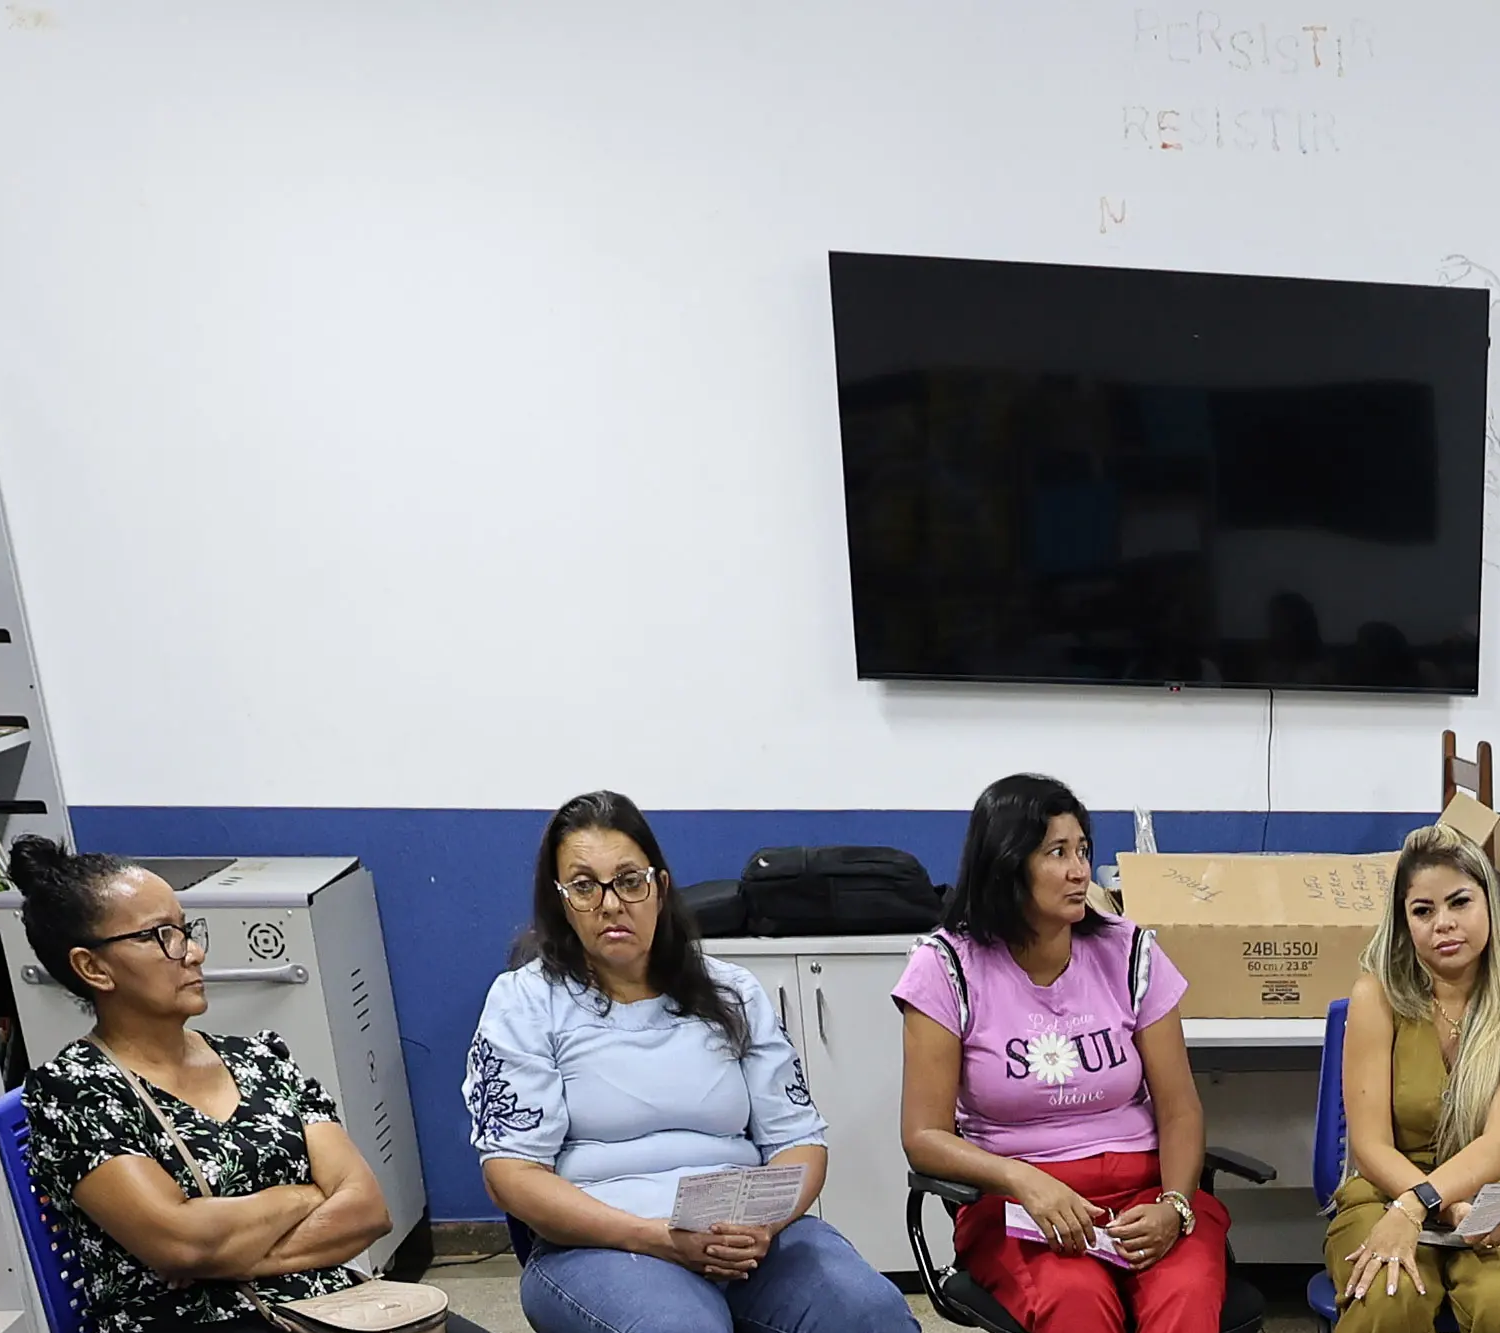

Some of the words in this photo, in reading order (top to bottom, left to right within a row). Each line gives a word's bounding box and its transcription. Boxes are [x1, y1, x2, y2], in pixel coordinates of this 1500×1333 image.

[1242, 942, 1318, 956] 24BLS50J
[1248, 961, 1261, 971] 60
[1263, 963, 1277, 971] cm
[1048, 1085, 1105, 1105] shine
